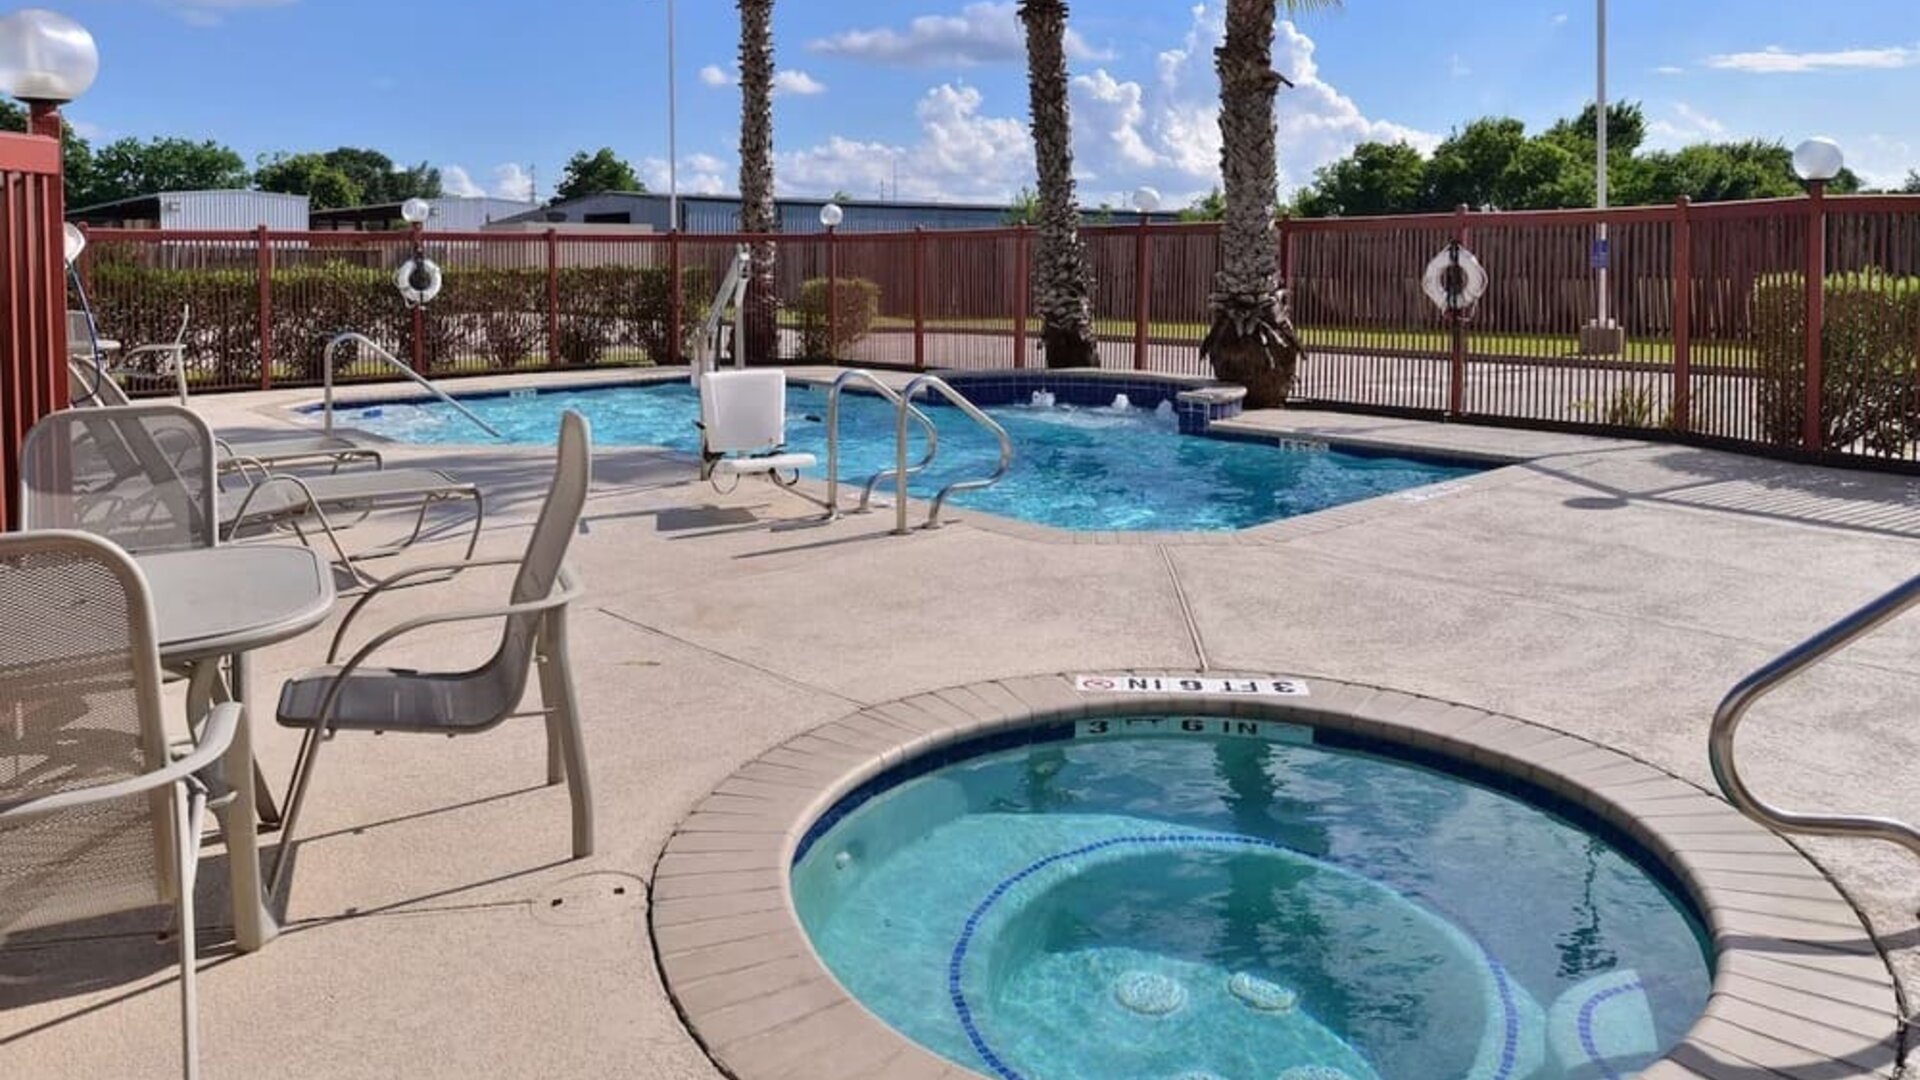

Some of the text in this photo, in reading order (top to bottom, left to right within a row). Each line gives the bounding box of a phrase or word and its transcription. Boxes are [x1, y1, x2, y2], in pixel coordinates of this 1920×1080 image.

[1128, 678, 1295, 693] 3 FT 6 IN
[1089, 720, 1109, 733] 3
[1182, 720, 1204, 731] 6
[1223, 721, 1258, 735] IN
